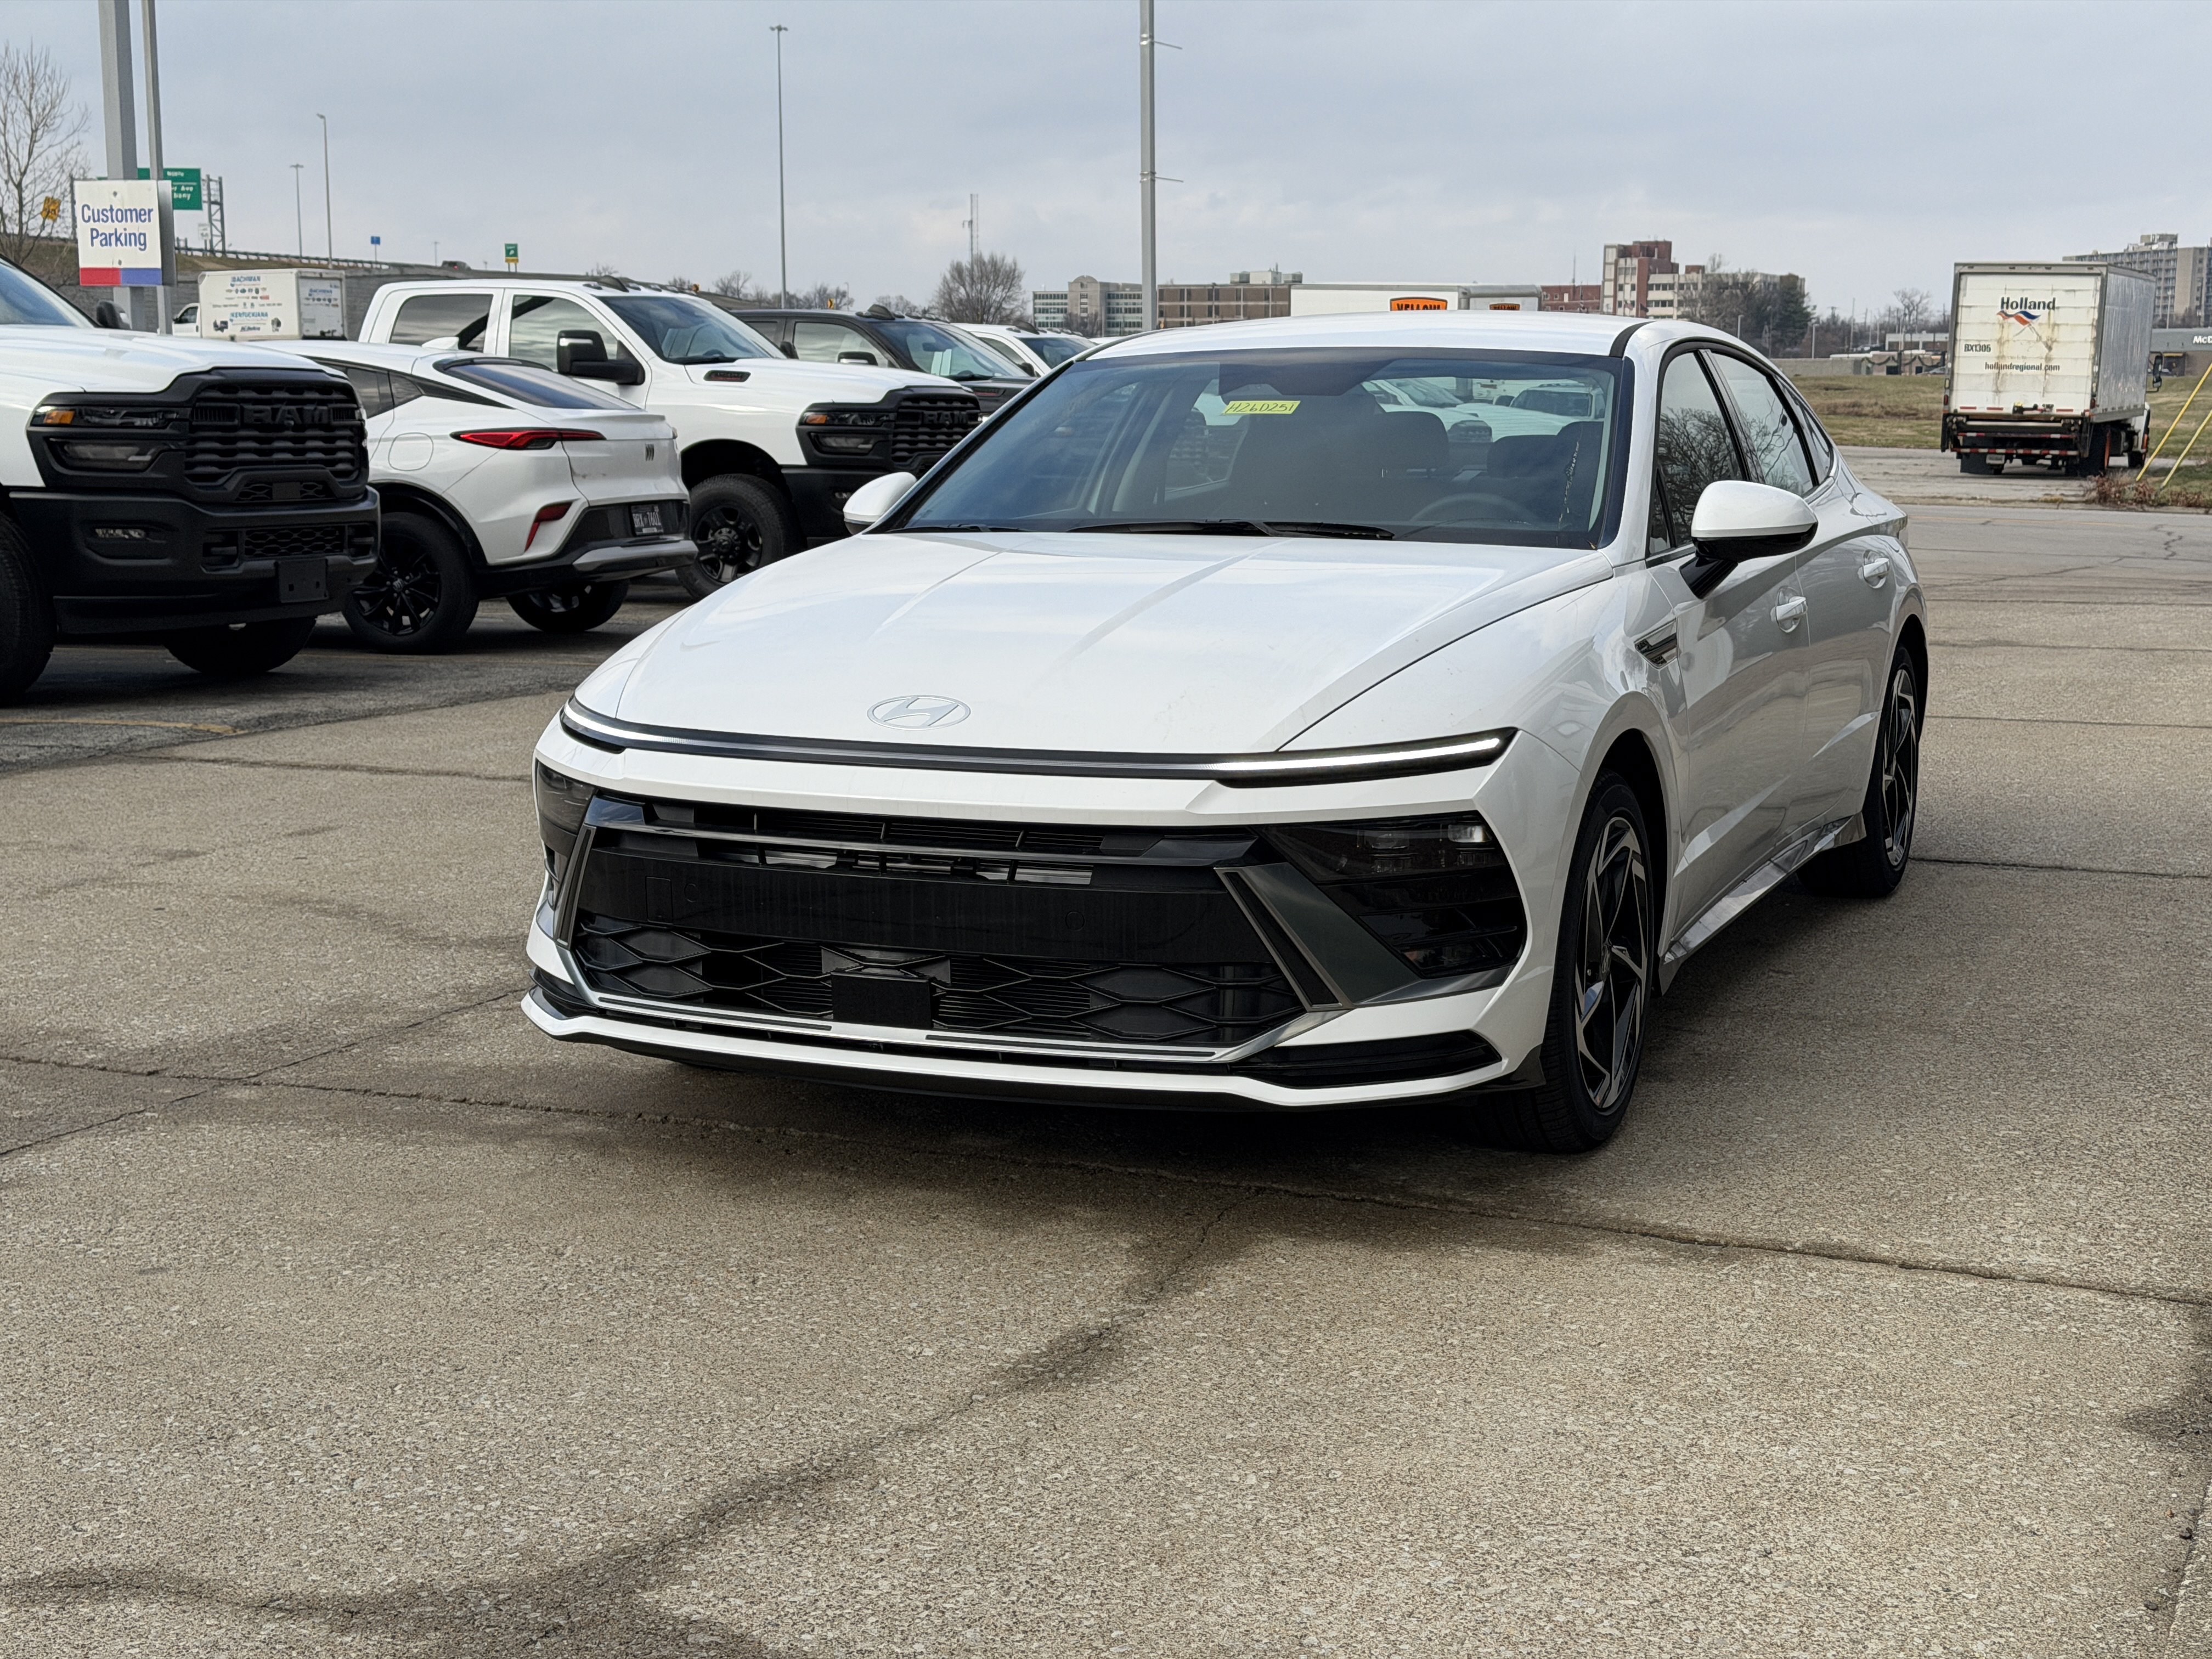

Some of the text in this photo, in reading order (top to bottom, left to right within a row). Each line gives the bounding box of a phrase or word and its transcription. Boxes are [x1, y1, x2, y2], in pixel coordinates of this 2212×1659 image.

[81, 204, 154, 223] Customer
[90, 228, 147, 251] Parking
[2000, 297, 2056, 311] Holland
[243, 404, 329, 425] RAM
[922, 410, 966, 424] RAM
